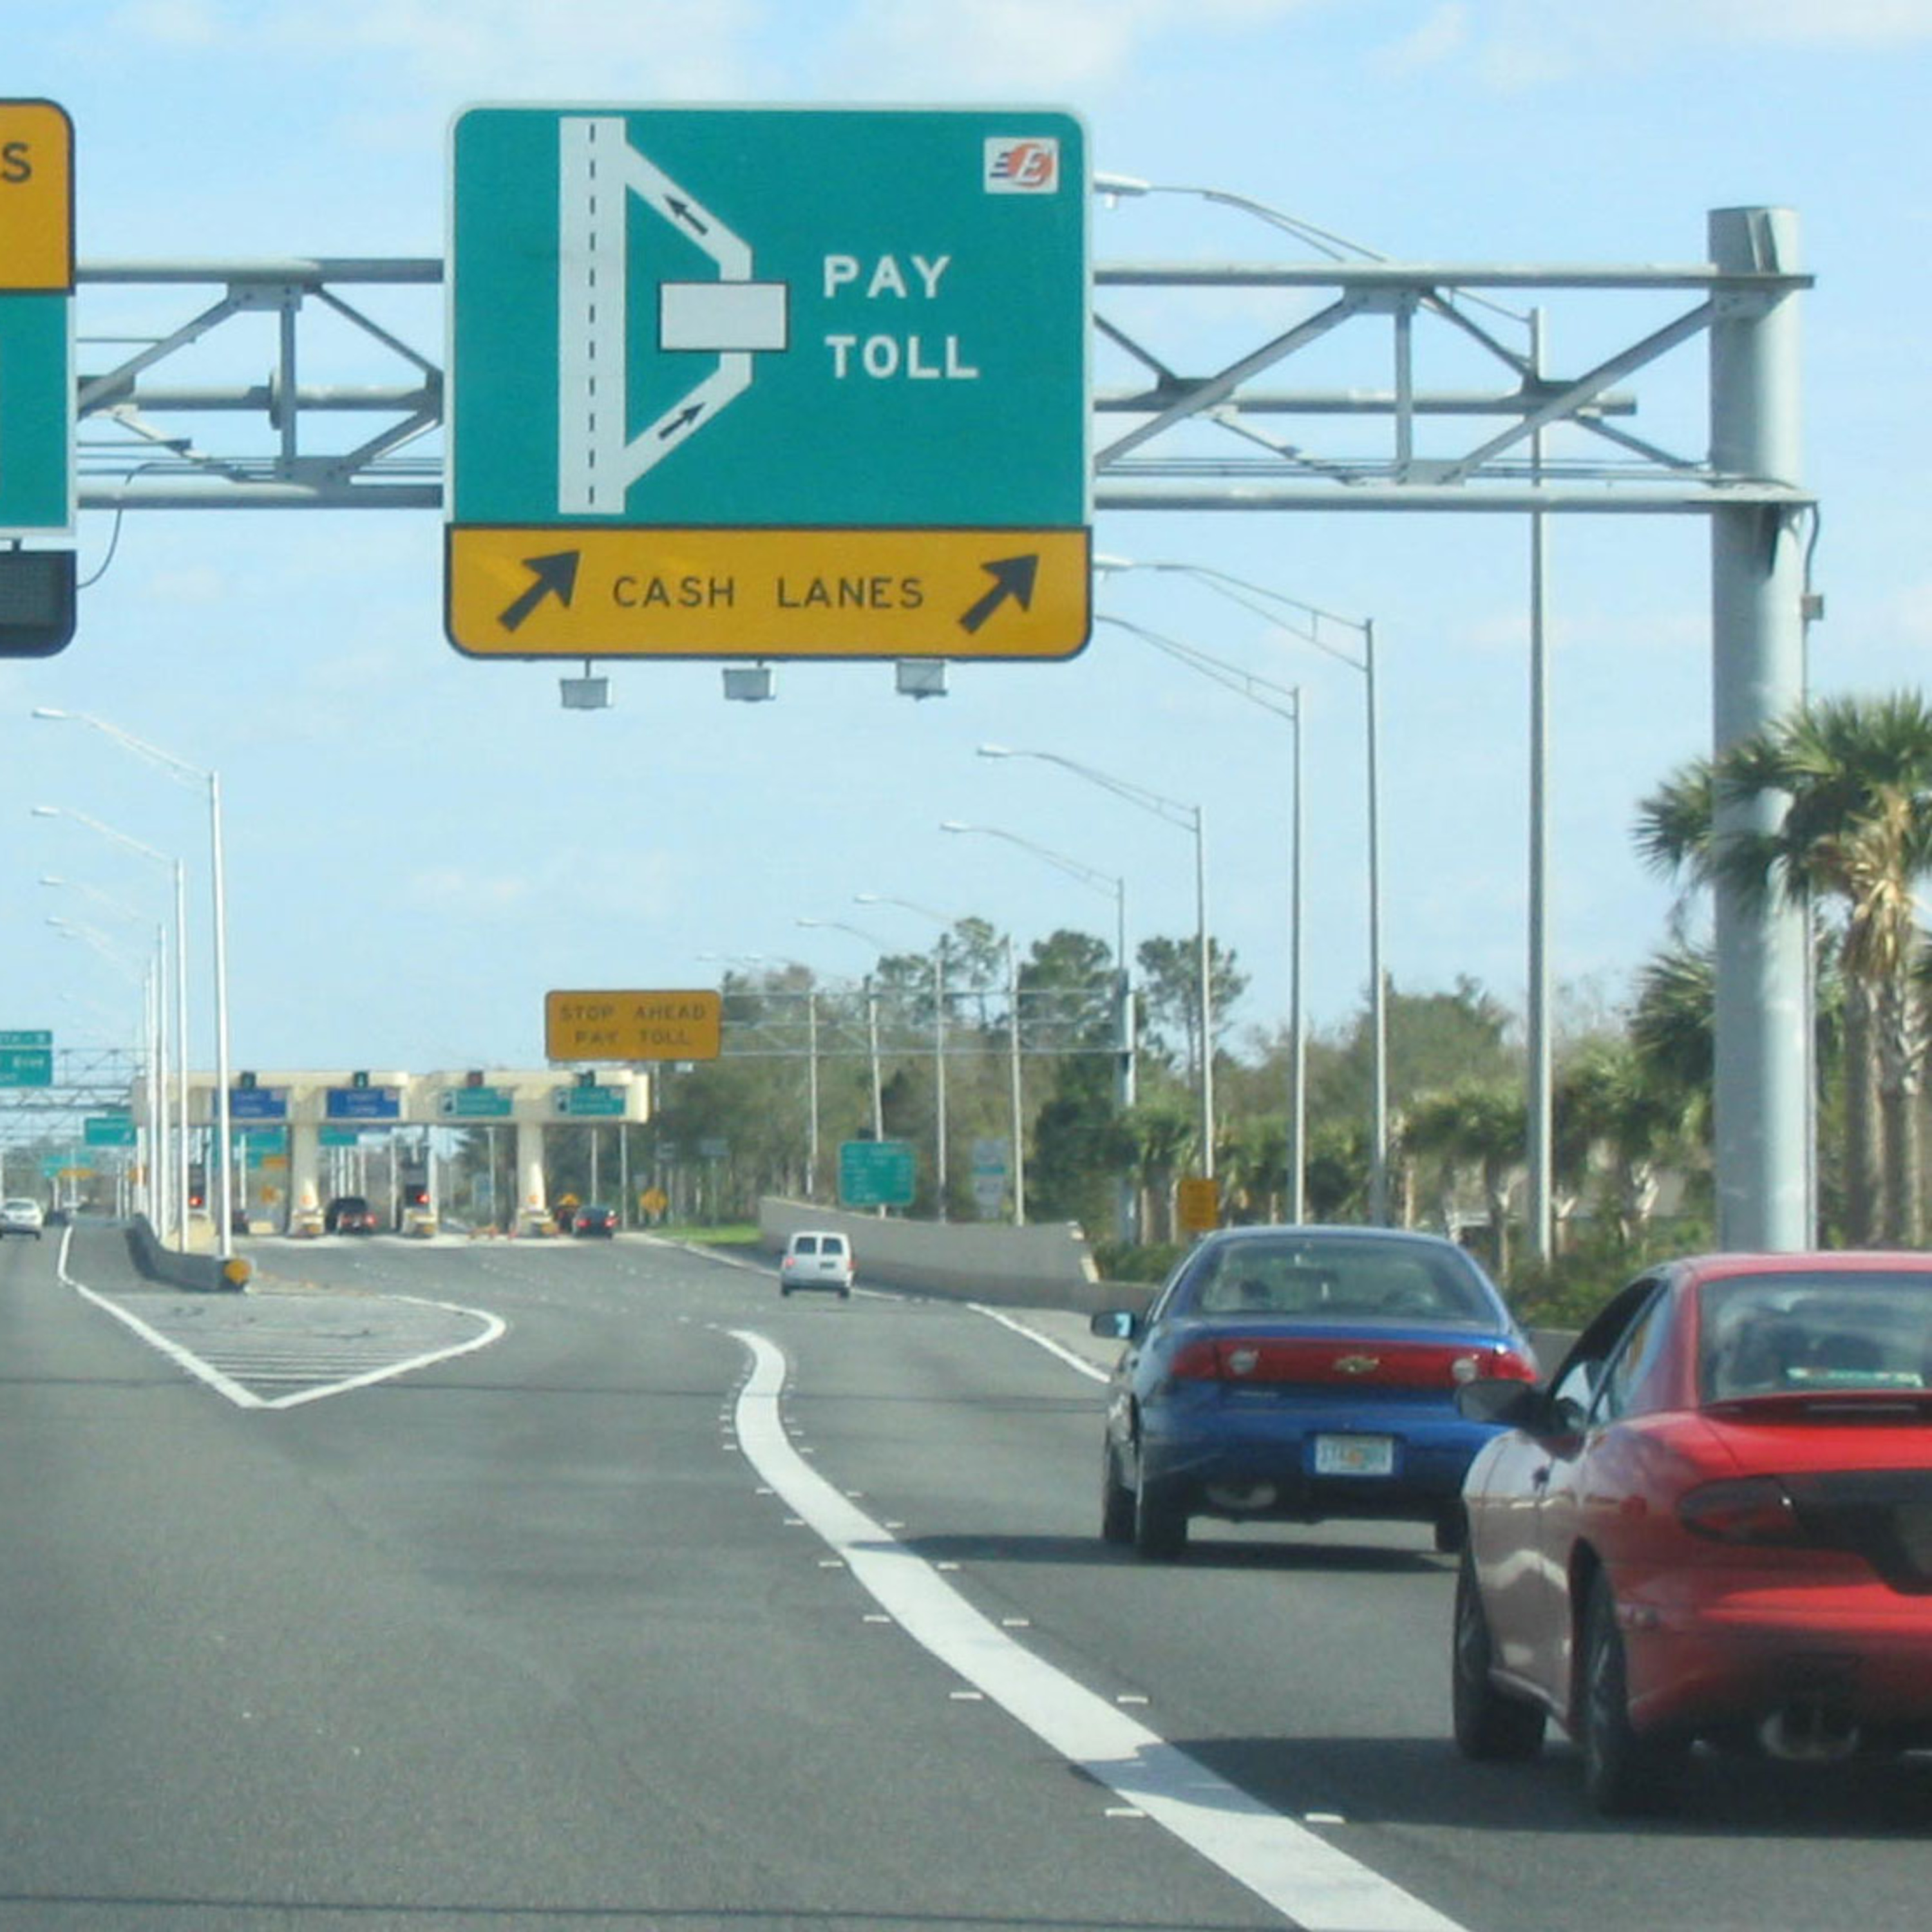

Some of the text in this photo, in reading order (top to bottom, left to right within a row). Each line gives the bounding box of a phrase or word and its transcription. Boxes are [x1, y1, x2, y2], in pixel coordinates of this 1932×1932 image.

[824, 254, 952, 298] PAY
[824, 334, 979, 379] TOLL
[613, 576, 924, 608] CASH LANES
[561, 1005, 706, 1022] STOP AHEAD
[575, 1030, 690, 1045] PAY TOLL
